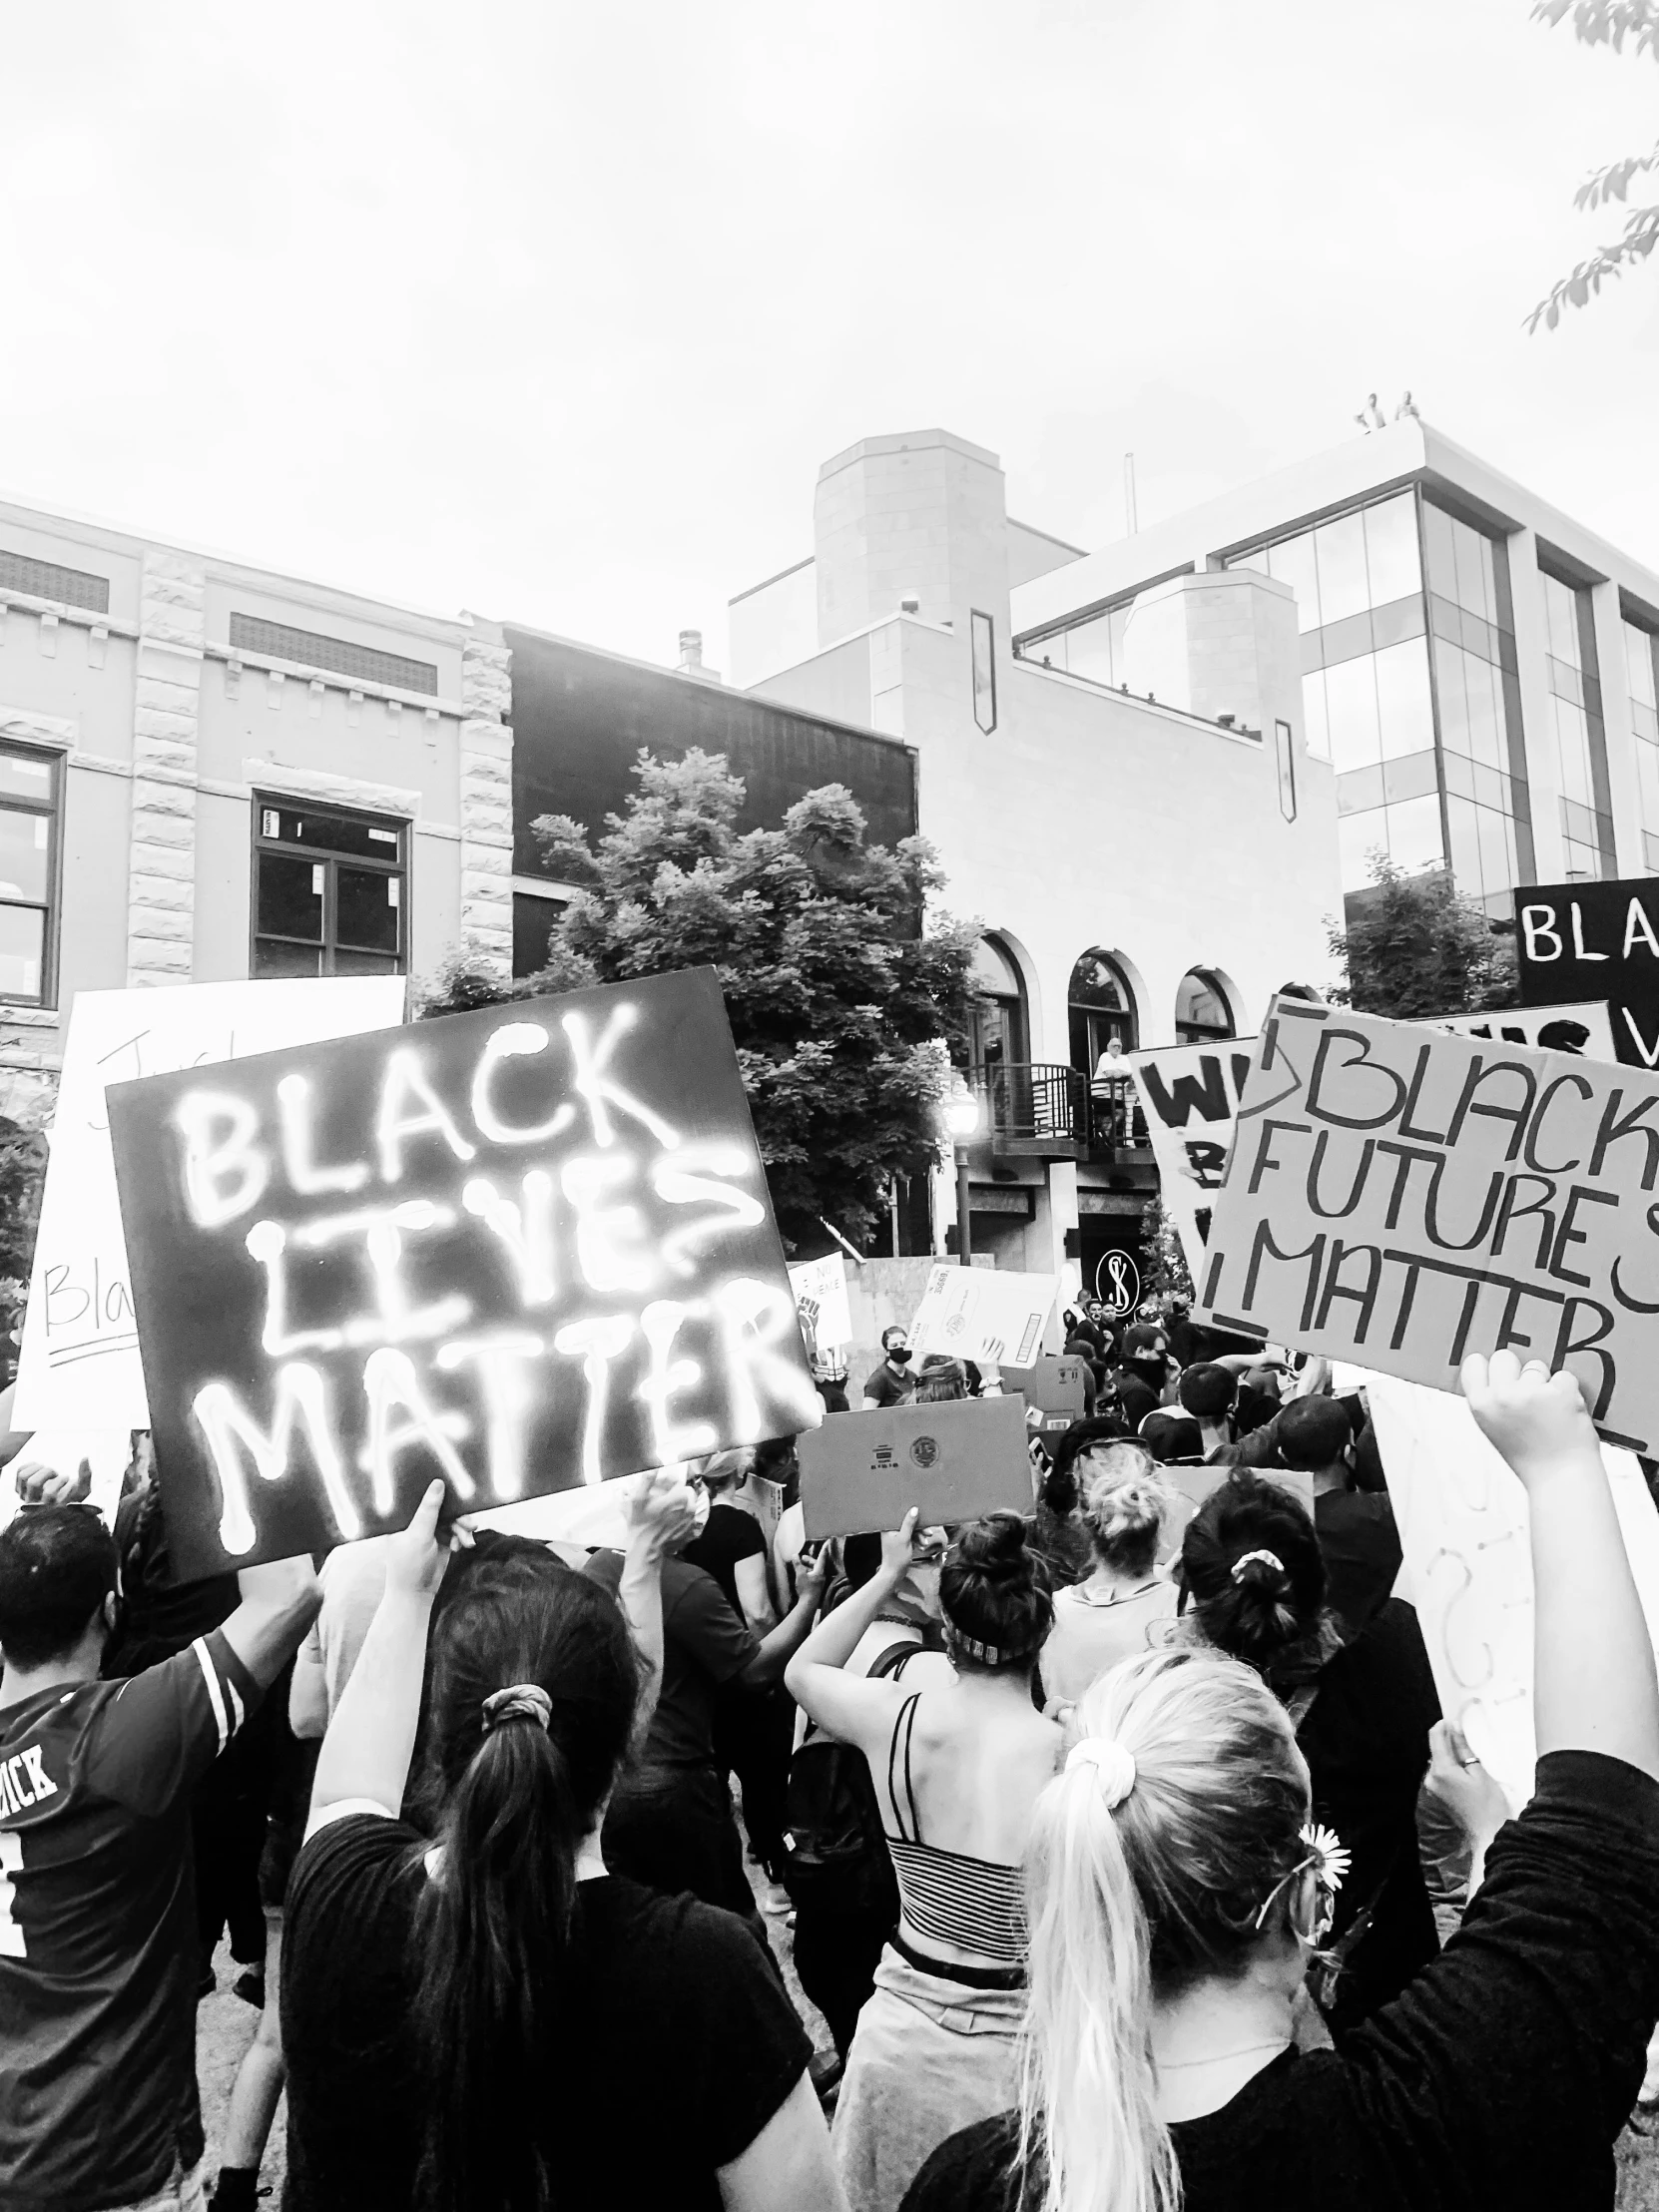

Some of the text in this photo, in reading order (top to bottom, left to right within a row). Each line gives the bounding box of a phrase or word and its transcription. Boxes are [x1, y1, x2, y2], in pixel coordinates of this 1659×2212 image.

[1521, 896, 1659, 962] BLA
[175, 1002, 681, 1228] BLACK
[1305, 1028, 1659, 1191] BLACK
[244, 1146, 766, 1356] LIVES
[1242, 1218, 1617, 1421] MATTER
[190, 1278, 825, 1555] MATTER
